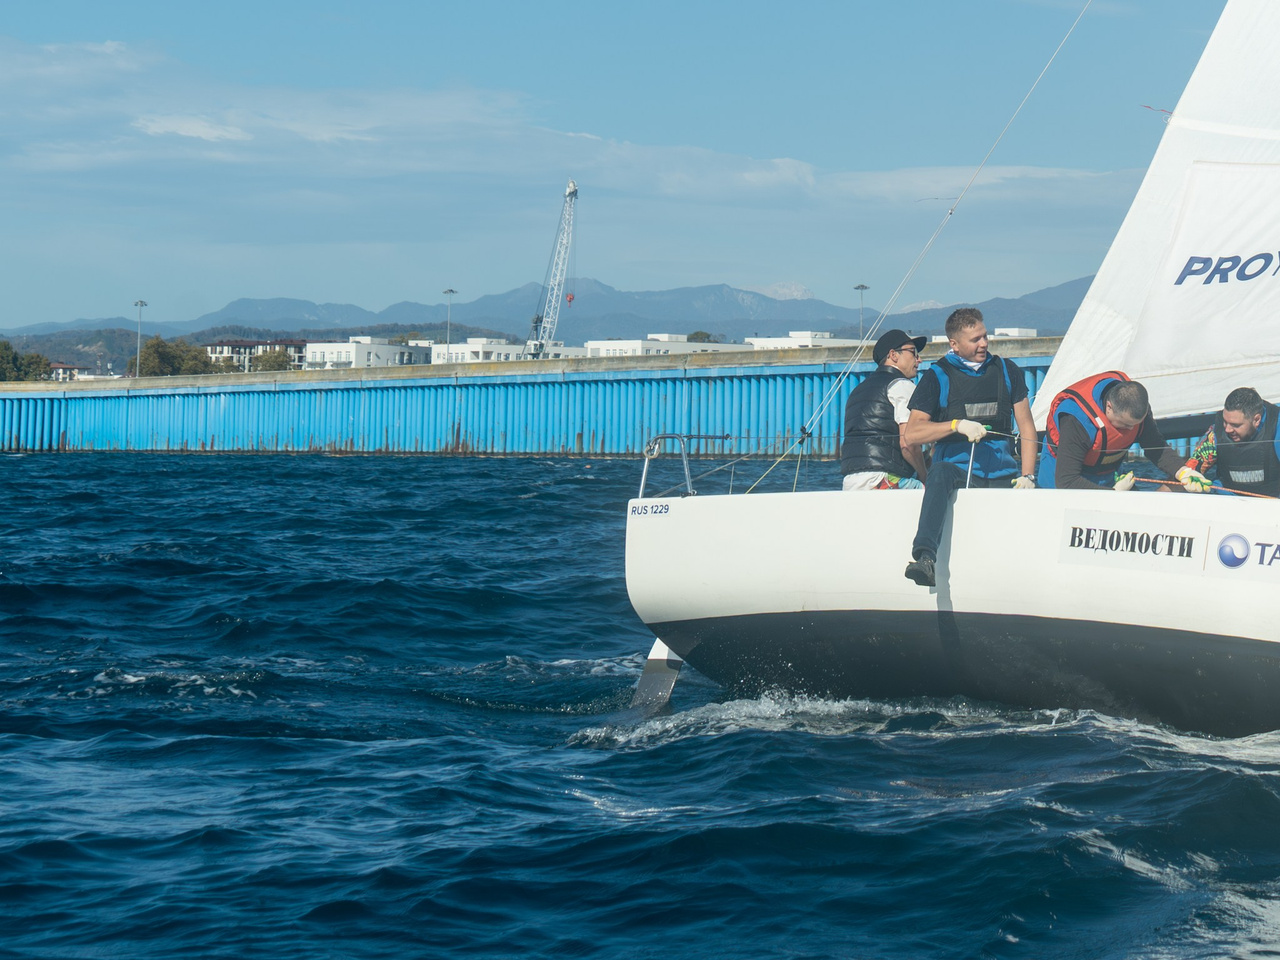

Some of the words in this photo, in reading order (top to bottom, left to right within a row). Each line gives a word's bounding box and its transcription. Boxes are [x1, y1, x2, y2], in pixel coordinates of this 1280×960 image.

[631, 505, 648, 515] RUS
[650, 504, 670, 515] 1229
[1069, 527, 1195, 559] ВЕДОМОСТИ
